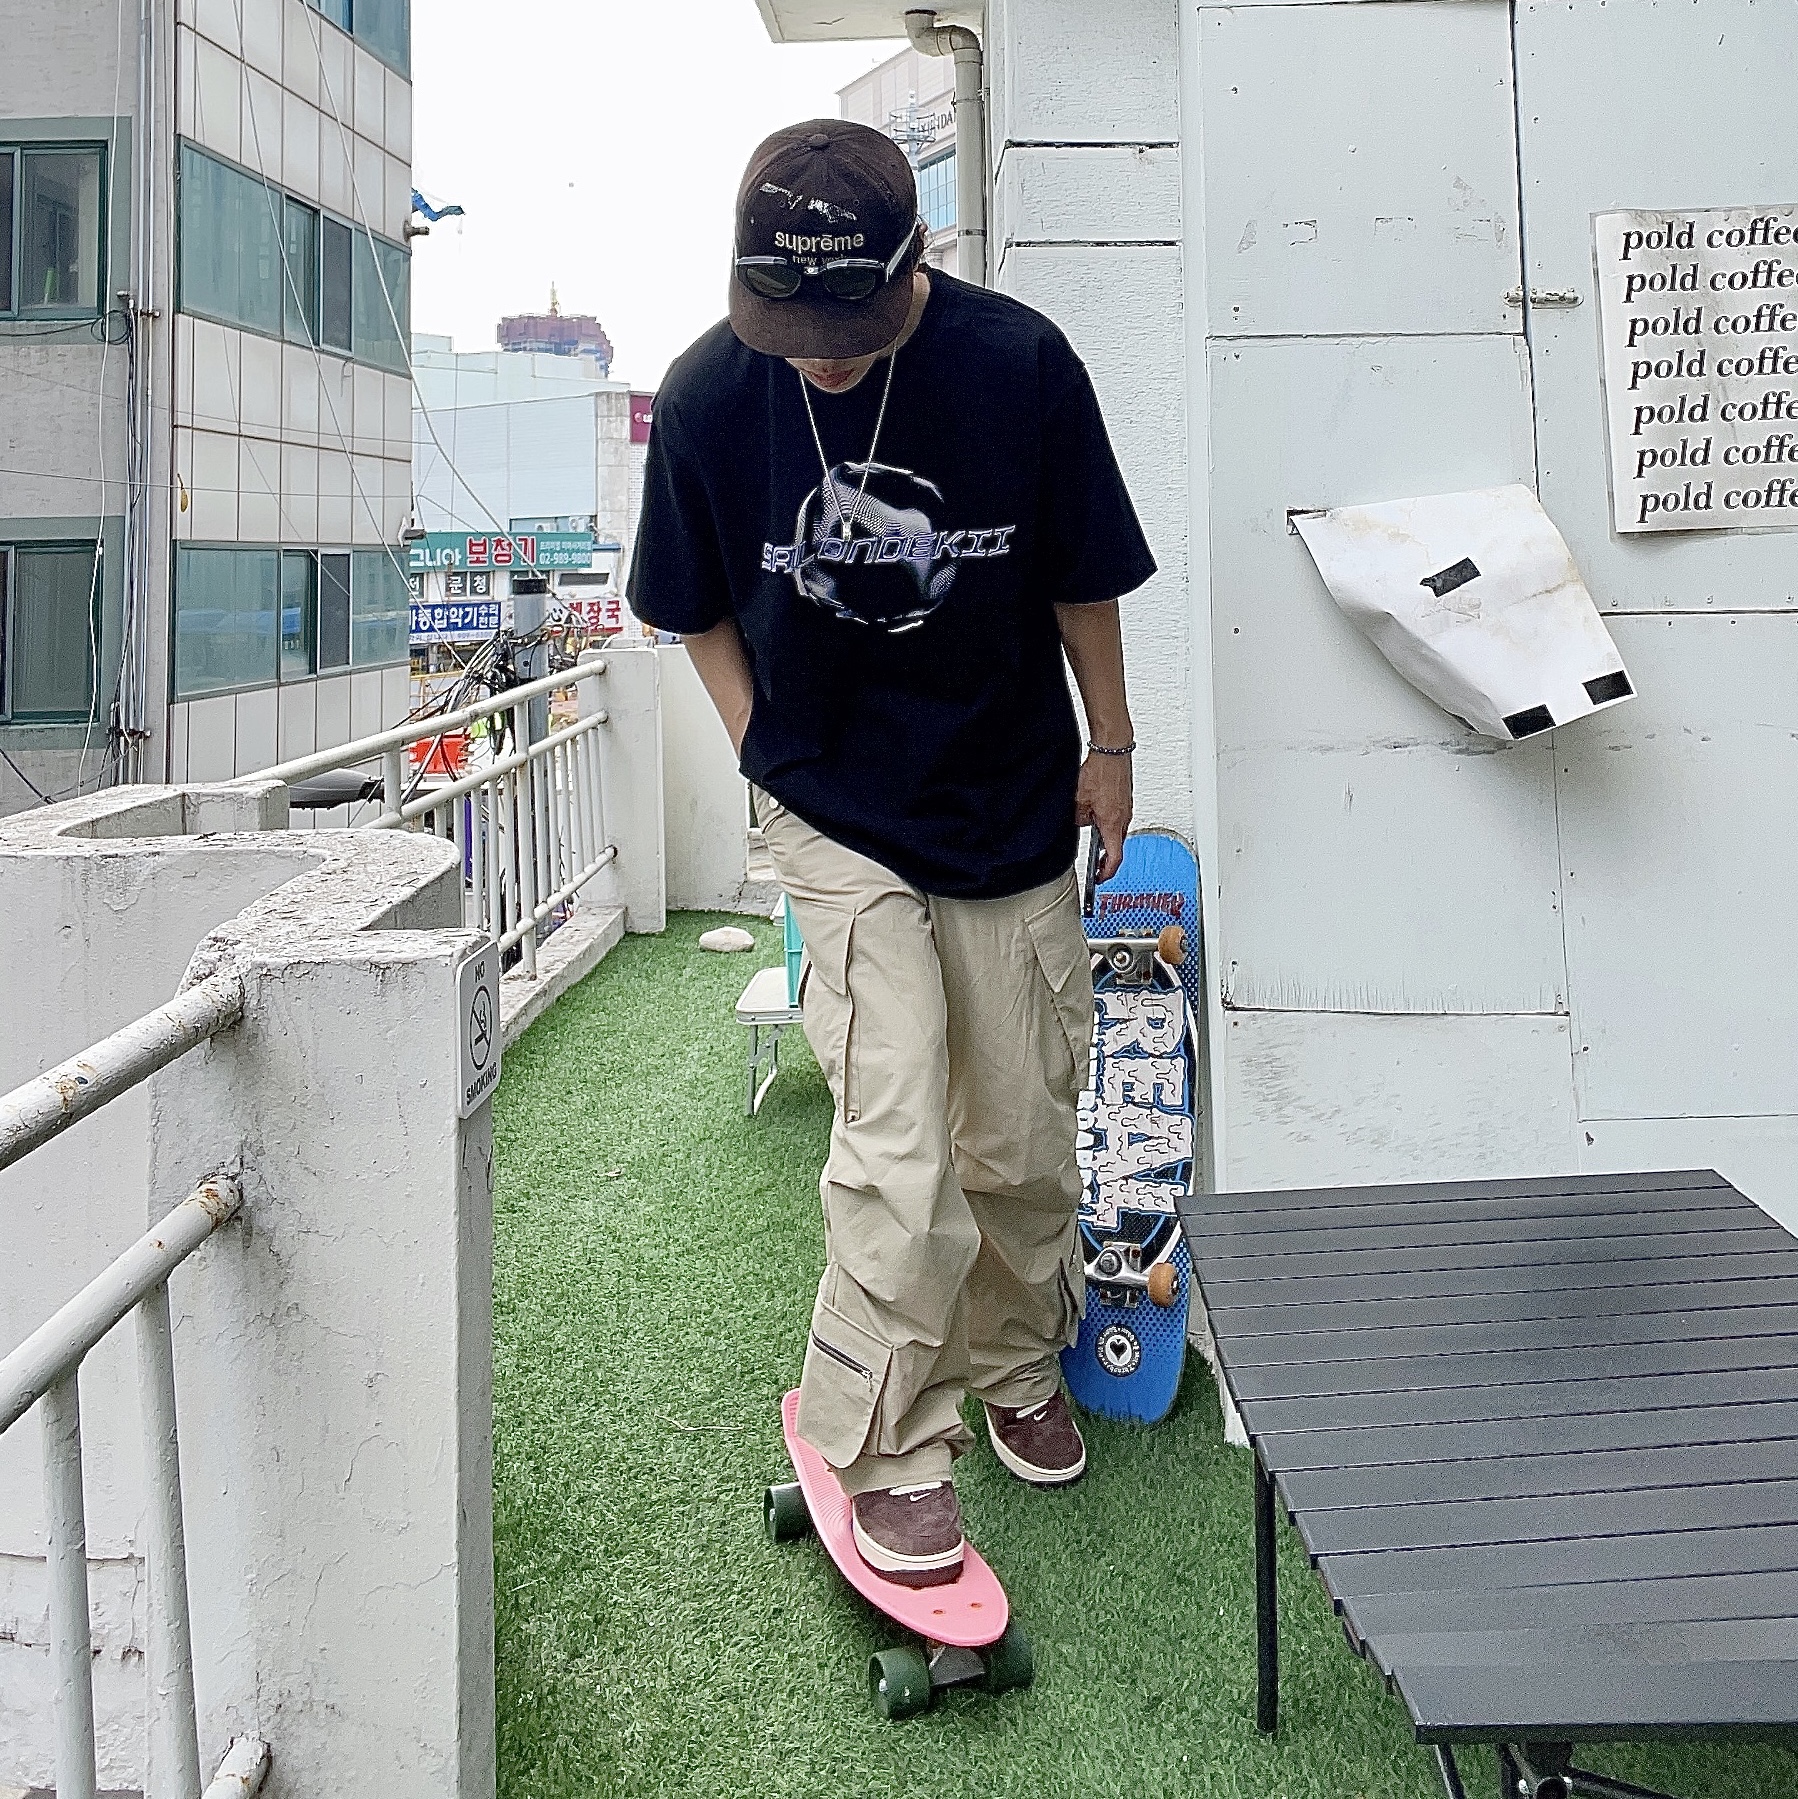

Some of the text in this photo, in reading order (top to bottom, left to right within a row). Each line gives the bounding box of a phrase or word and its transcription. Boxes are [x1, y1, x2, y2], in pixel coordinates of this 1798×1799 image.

[792, 255, 818, 266] new
[1619, 221, 1695, 261] pold
[1622, 259, 1798, 303] pold coffe
[1625, 307, 1703, 347] pold
[1627, 346, 1798, 390] pold coffe
[1630, 394, 1710, 435] pold
[1633, 437, 1712, 478] pold
[1636, 482, 1713, 523] pold
[466, 536, 537, 567] 보청기
[474, 960, 486, 984] NO
[465, 1061, 498, 1106] SMOKING
[1079, 988, 1194, 1229] REAL
